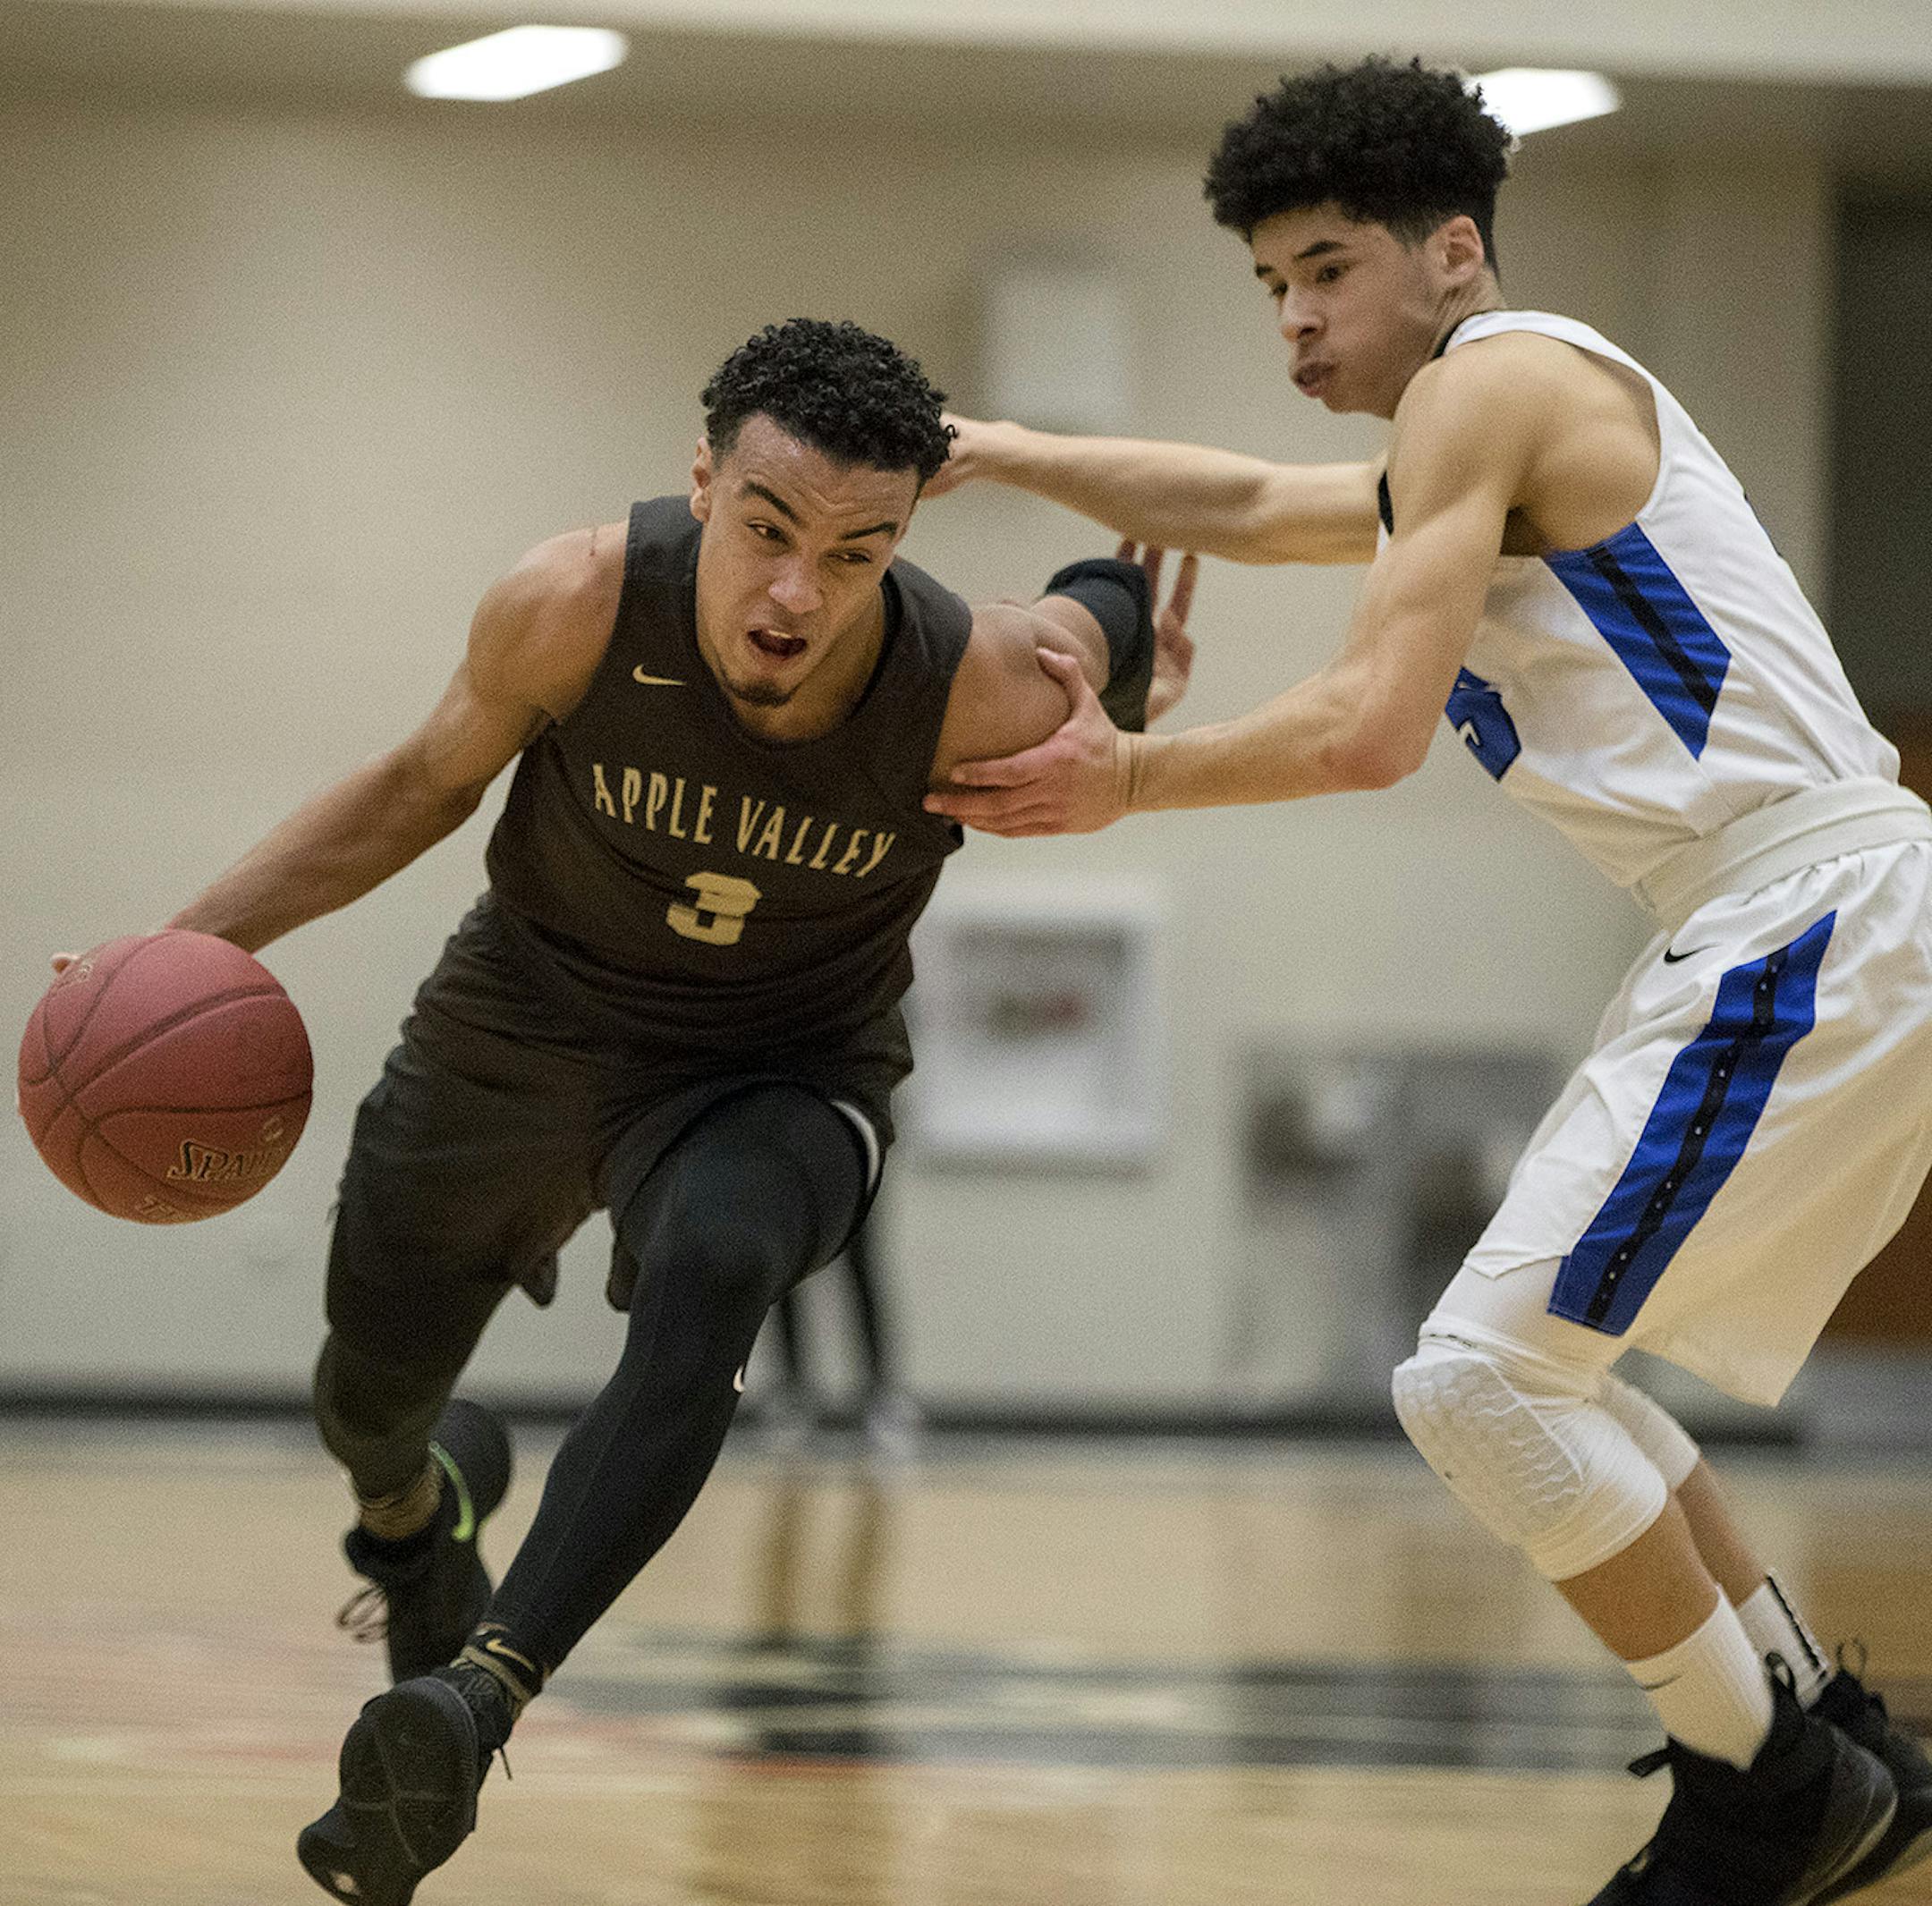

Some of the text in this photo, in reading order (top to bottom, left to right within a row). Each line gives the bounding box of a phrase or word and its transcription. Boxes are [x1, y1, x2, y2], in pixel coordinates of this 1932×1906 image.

[592, 763, 896, 878] APPLE VALLEY
[665, 870, 763, 946] 3
